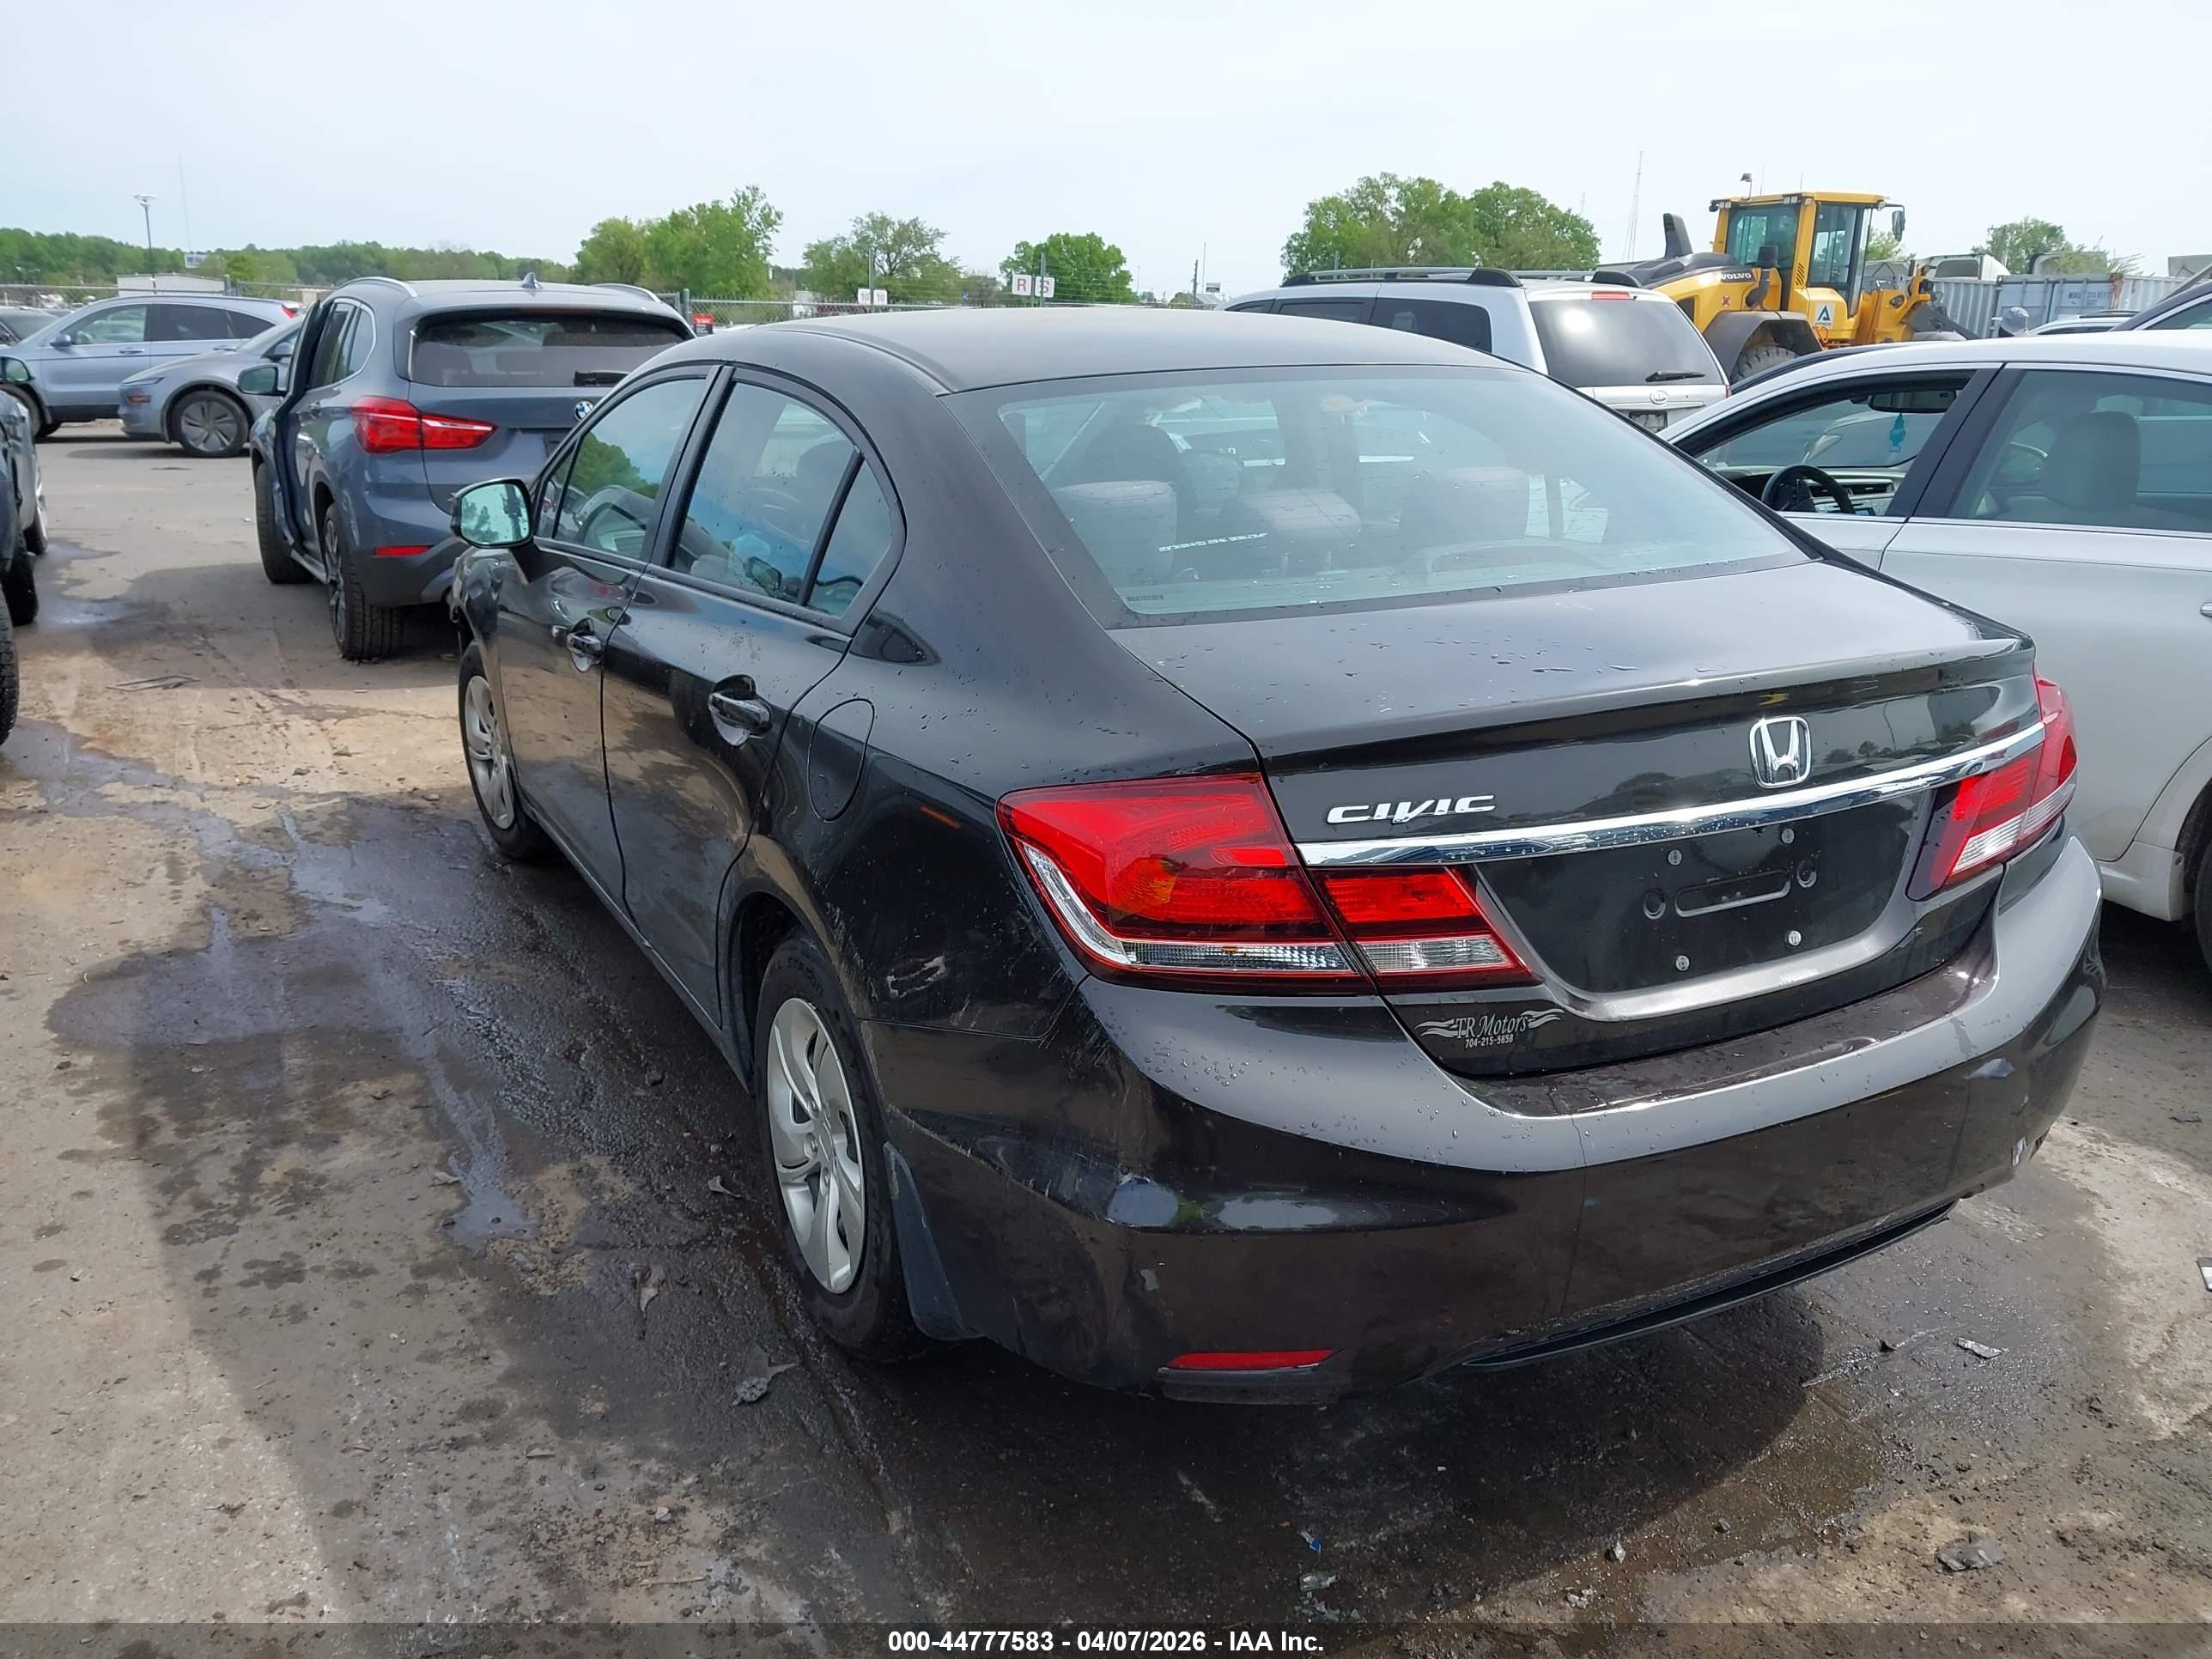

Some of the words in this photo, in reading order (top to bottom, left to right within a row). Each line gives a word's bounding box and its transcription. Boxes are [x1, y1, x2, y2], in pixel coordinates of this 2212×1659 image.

[1017, 278, 1027, 292] R
[1039, 280, 1049, 294] S
[860, 293, 870, 301] 10
[876, 294, 885, 302] 10
[1327, 794, 1496, 824] CIVIC
[1455, 1017, 1475, 1038] TR
[1477, 1013, 1528, 1037] Motors
[1465, 1034, 1514, 1048] 704-215-5658
